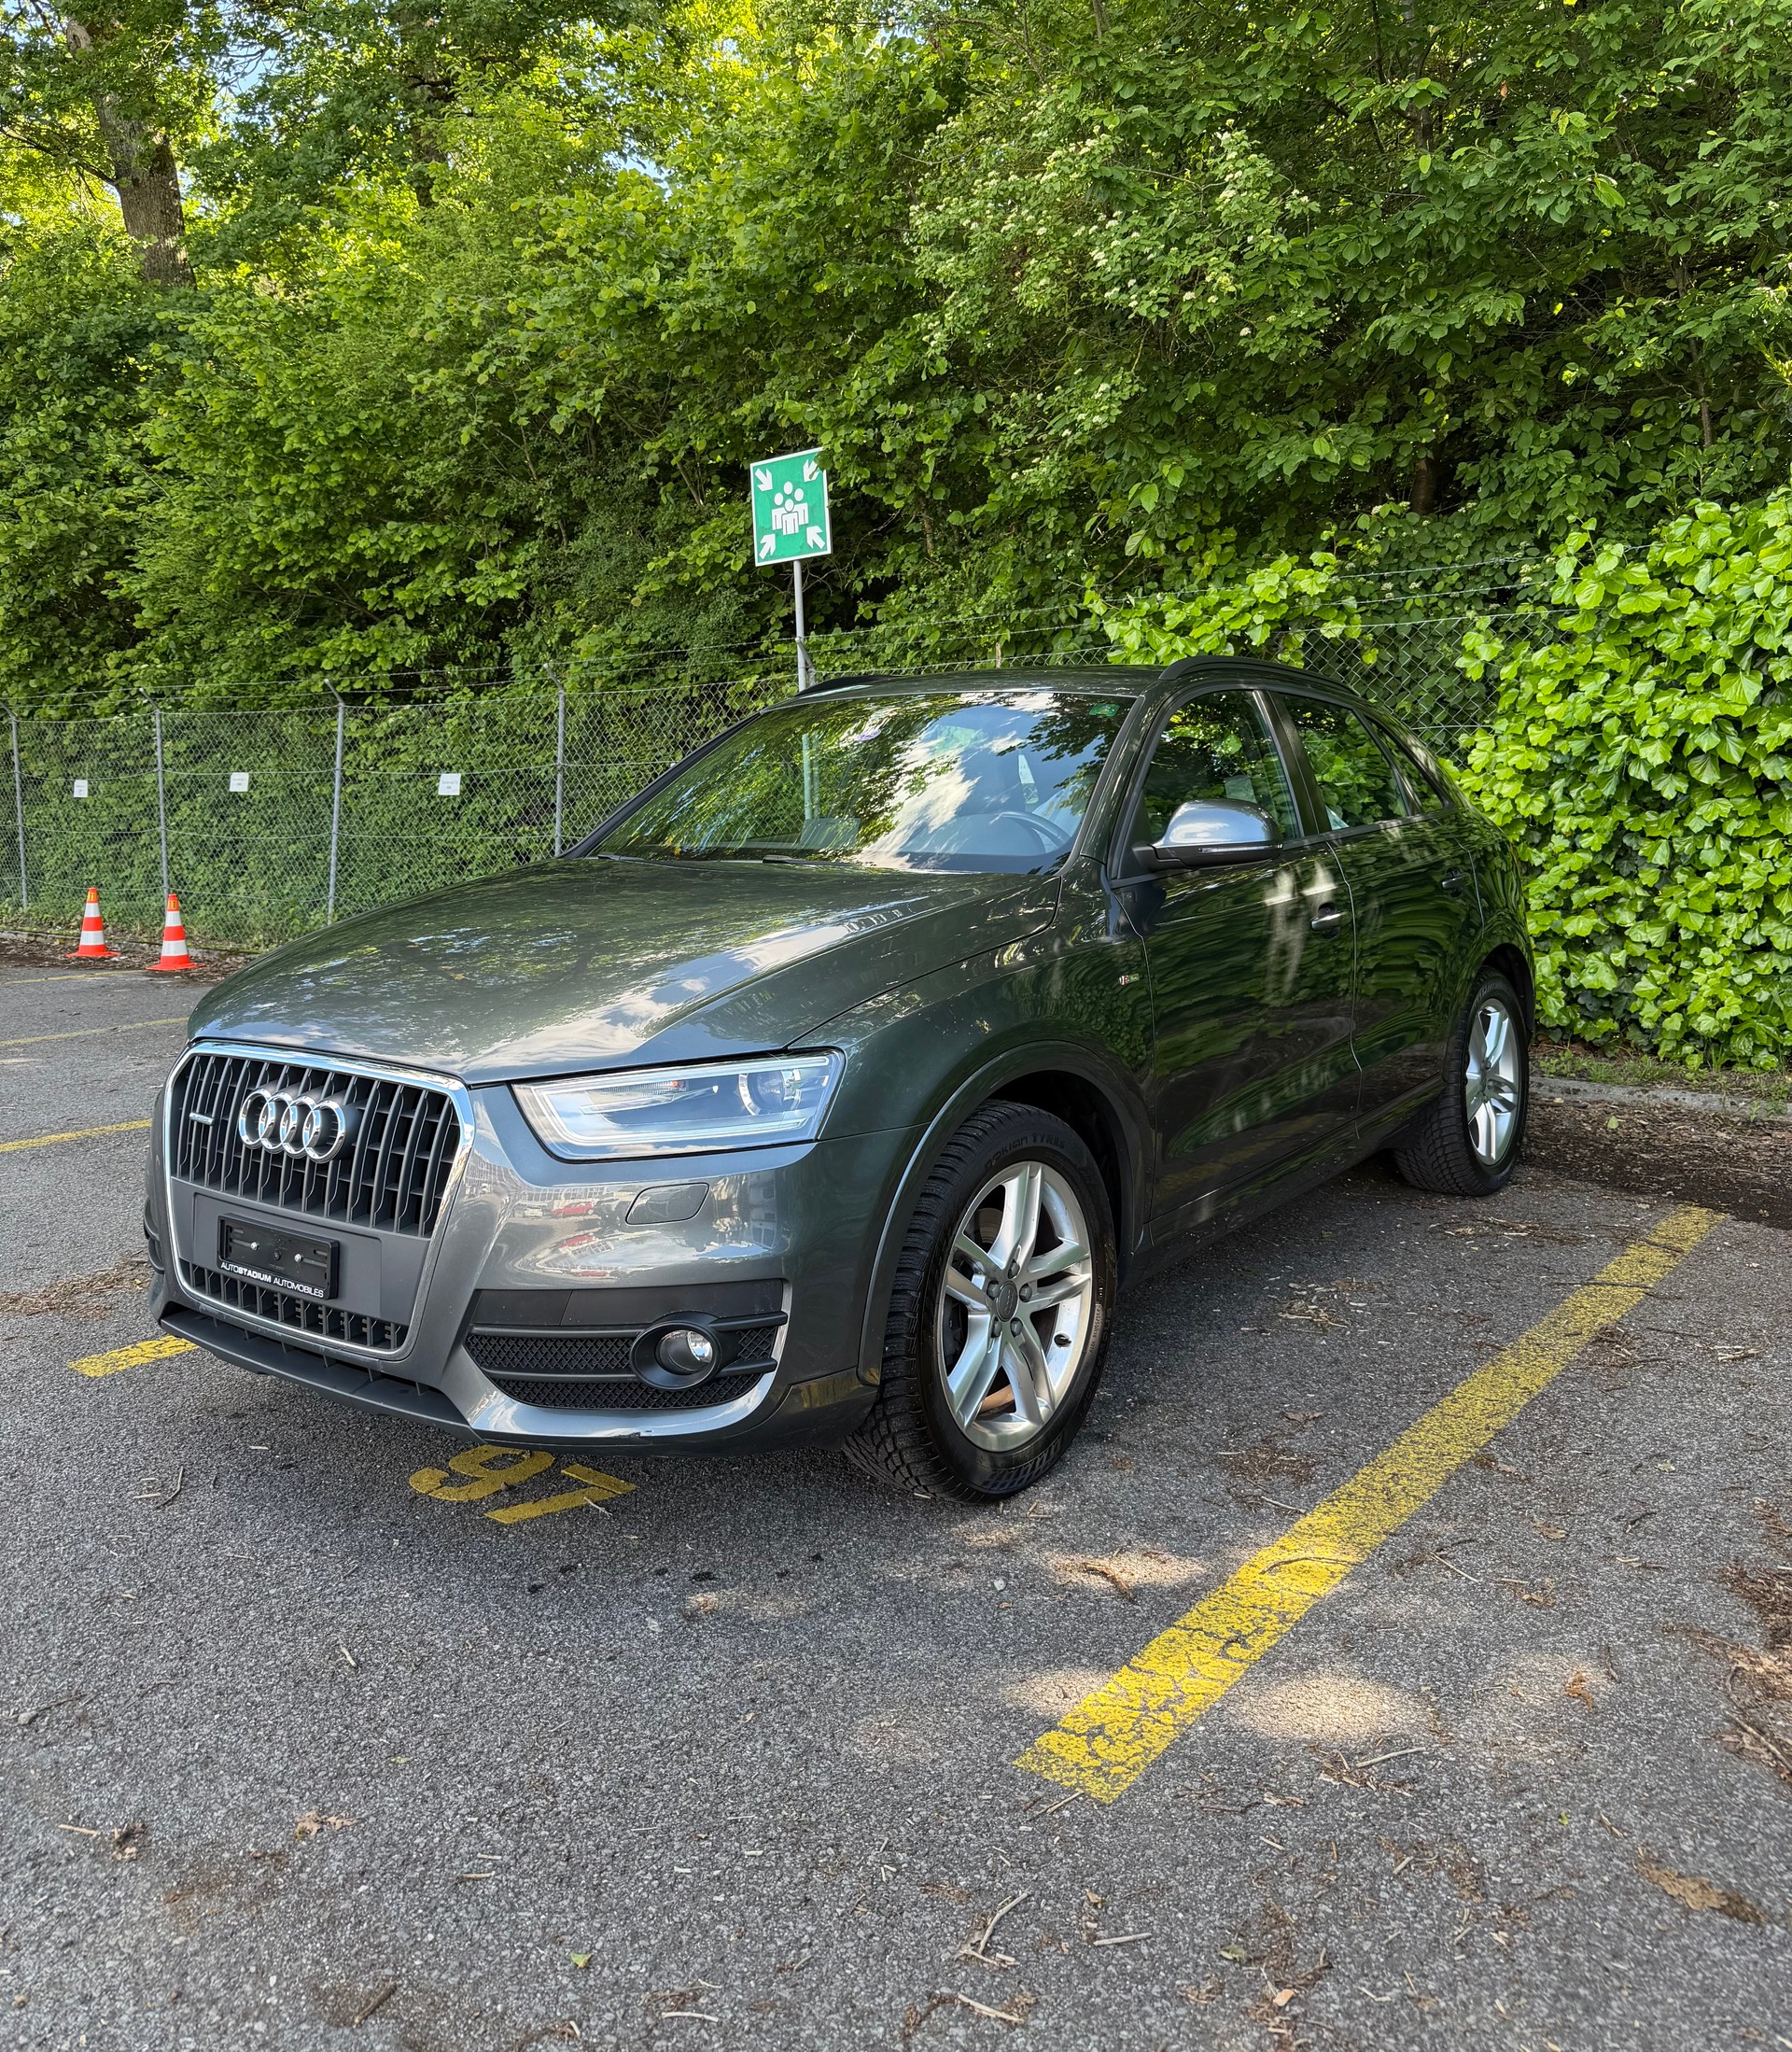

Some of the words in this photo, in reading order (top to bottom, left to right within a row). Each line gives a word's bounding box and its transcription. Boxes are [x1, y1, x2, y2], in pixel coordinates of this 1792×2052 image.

[220, 1261, 272, 1283] AUTOSTADIUM
[273, 1277, 324, 1298] AUTOMOBILES
[409, 1444, 639, 1524] 97
